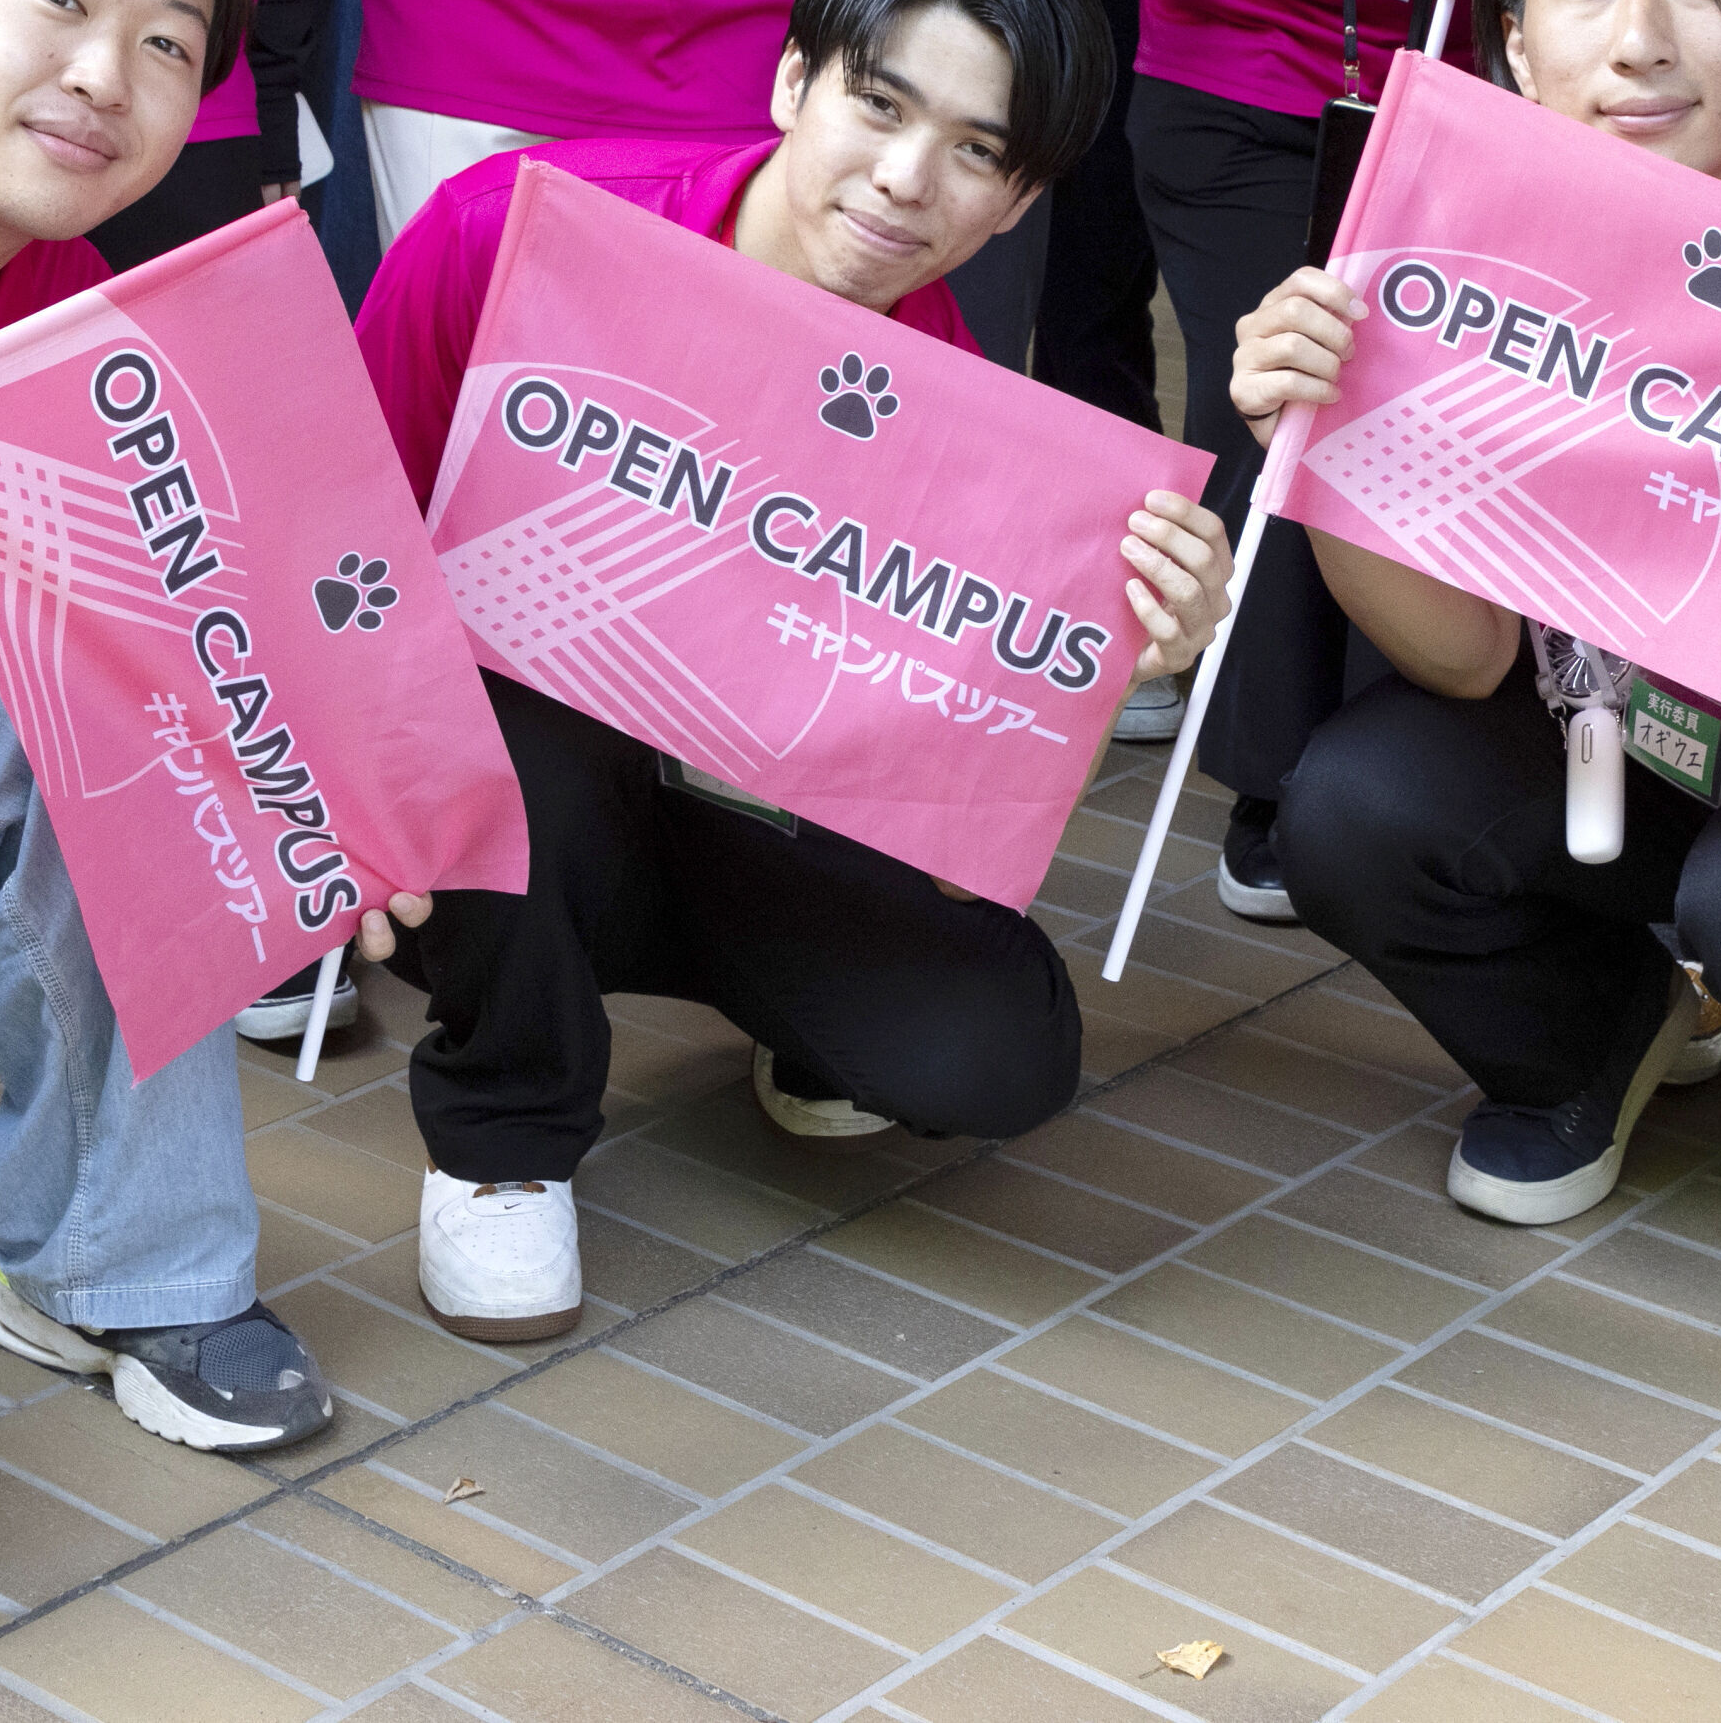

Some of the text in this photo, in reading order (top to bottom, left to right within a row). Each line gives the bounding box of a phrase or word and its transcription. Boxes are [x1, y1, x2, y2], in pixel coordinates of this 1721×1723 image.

[1378, 259, 1616, 405] OPEN
[501, 375, 1114, 693] OPEN CAMPUS
[89, 347, 364, 933] OPEN CAMPUS
[766, 602, 1069, 746] キャンパスツアー
[1647, 692, 1699, 733] 実行委員
[144, 691, 269, 964] キャンパスツアー
